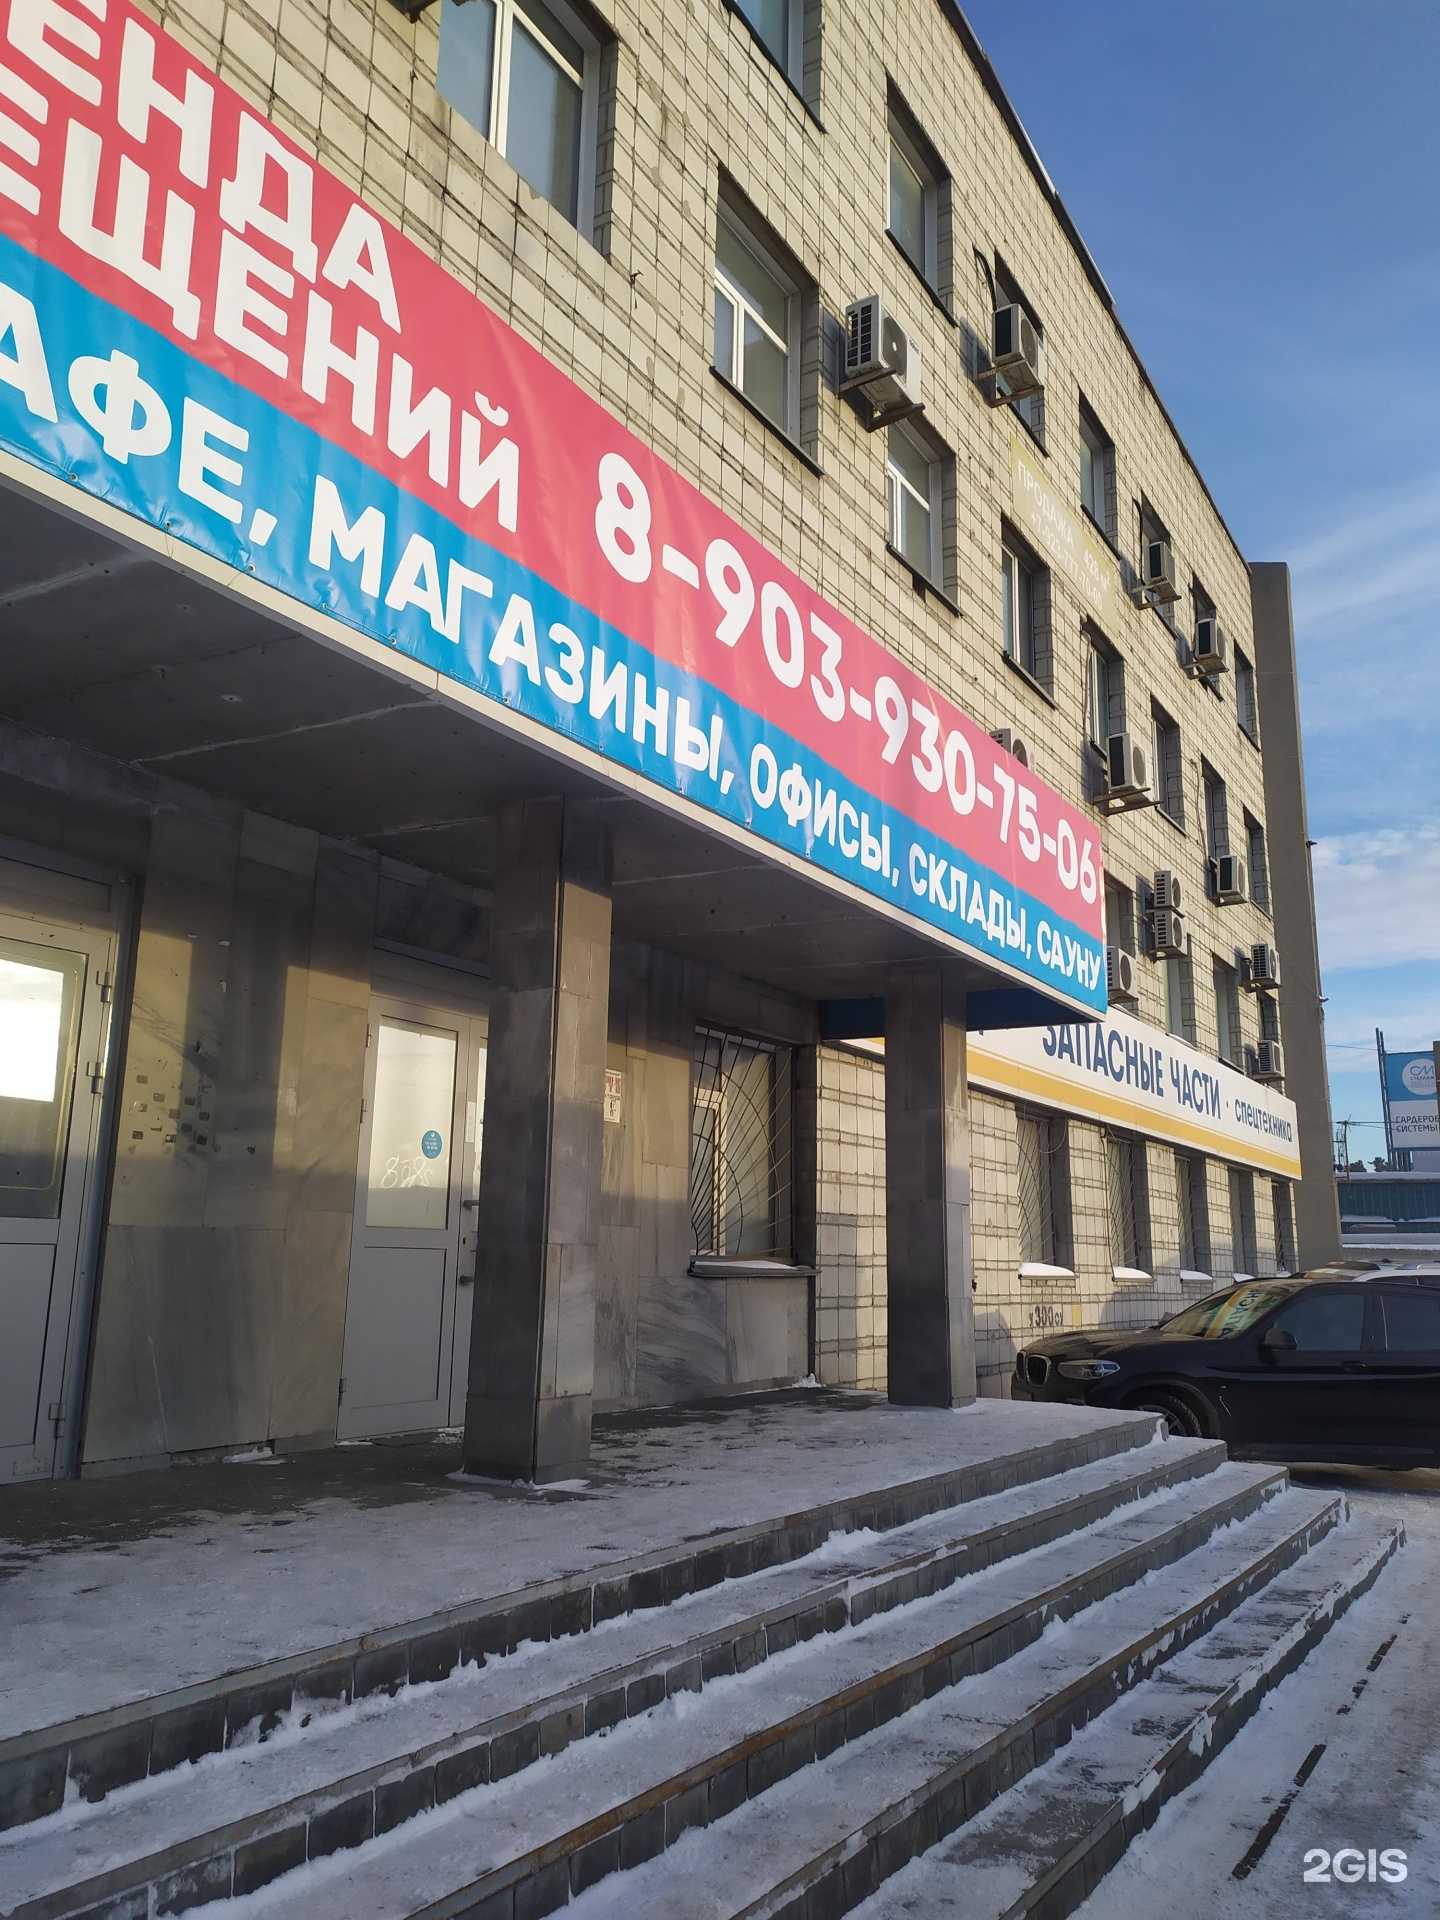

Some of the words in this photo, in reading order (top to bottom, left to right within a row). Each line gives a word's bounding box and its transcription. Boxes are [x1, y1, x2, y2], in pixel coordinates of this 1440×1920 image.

[308, 475, 735, 795] МАГАЗИНЫ,
[749, 743, 901, 888] ОФИСЫ,
[908, 842, 1032, 961] СКЛАДЫ,
[1036, 920, 1102, 991] САУНУ
[594, 452, 1097, 905] 8-903-930-75-06
[1043, 1023, 1164, 1097] ЗАПАСНЫЕ
[1168, 1056, 1222, 1120] ЧАСТИ
[1234, 1097, 1293, 1143] спецтехника
